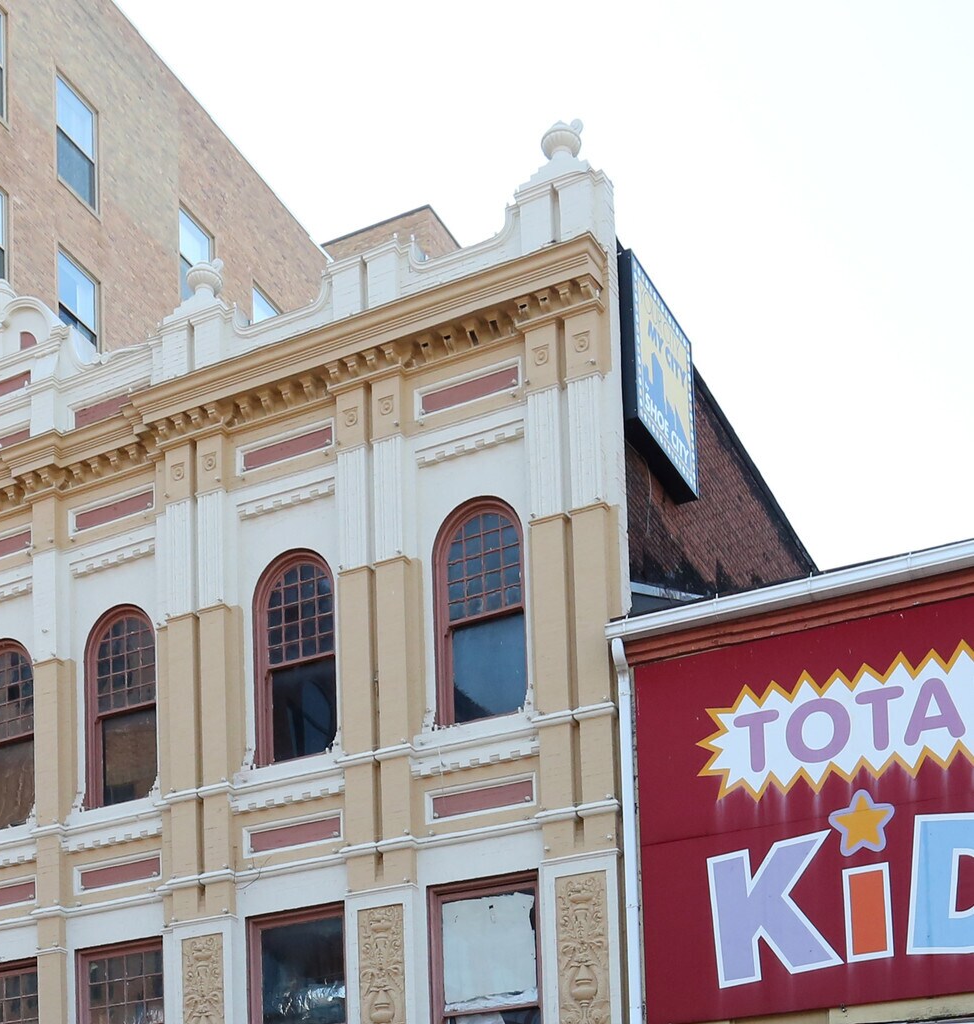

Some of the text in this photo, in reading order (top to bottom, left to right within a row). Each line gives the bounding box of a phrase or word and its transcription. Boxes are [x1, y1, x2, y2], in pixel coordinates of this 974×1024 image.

[647, 319, 686, 388] MY CITY
[644, 392, 689, 464] SHOE CITY
[733, 677, 966, 773] TOTA
